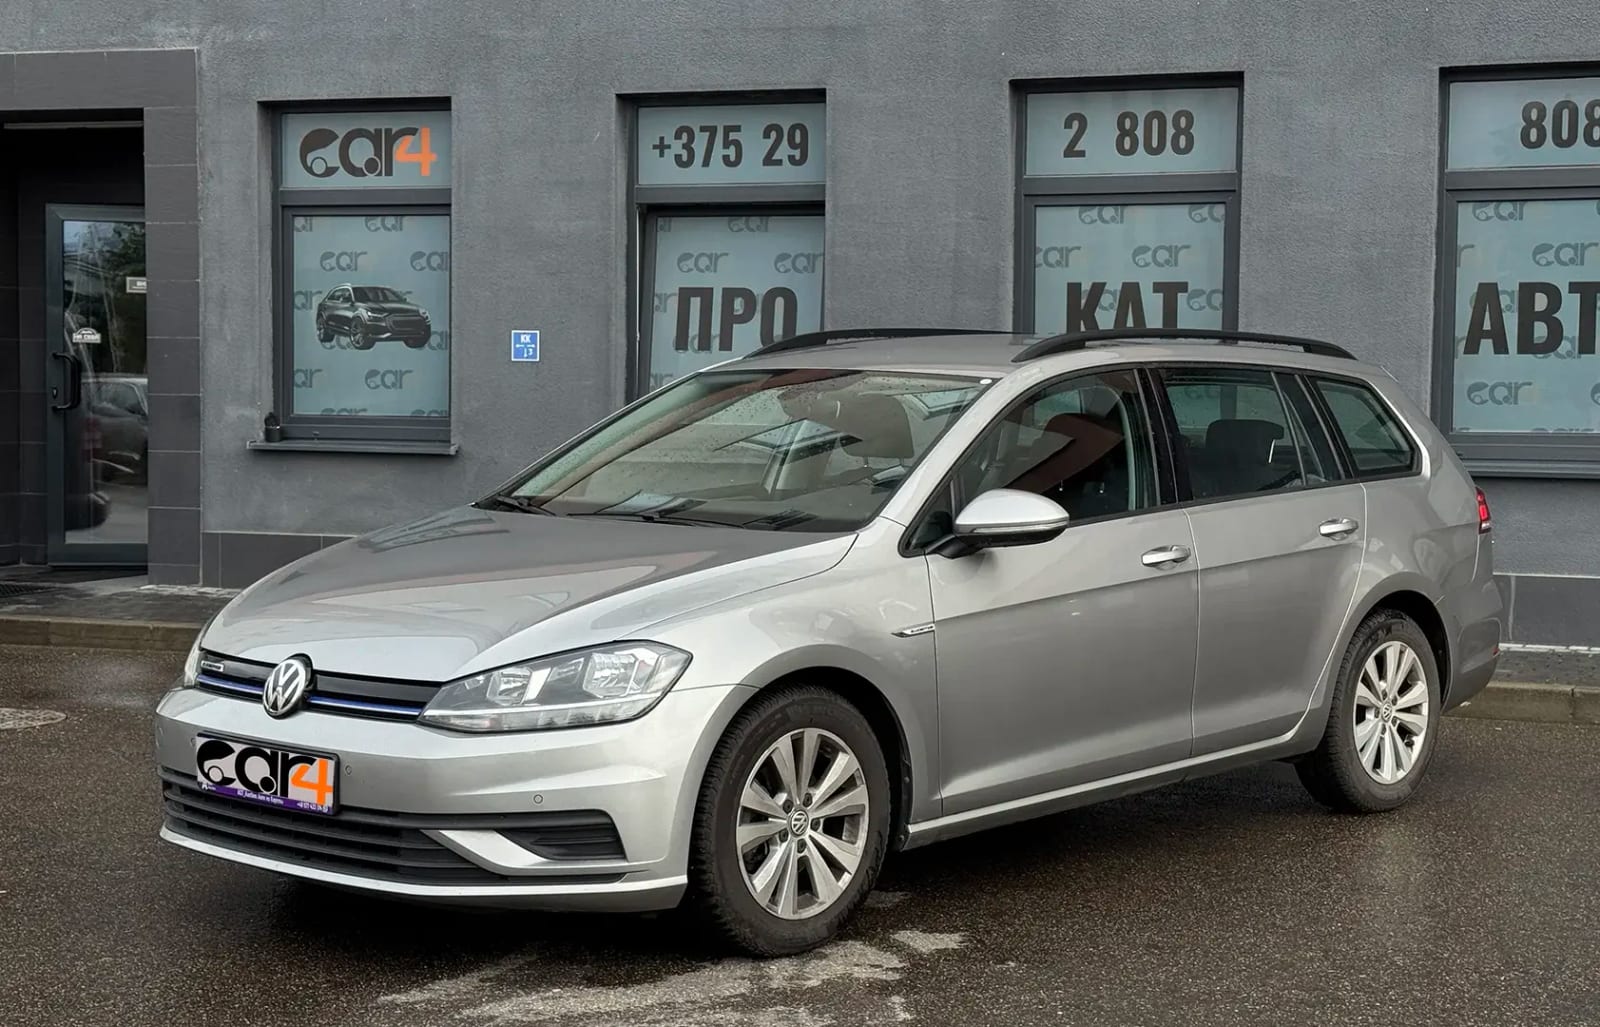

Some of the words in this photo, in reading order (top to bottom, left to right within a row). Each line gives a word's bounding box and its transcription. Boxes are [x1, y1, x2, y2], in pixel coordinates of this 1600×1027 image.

[652, 125, 743, 168] +375
[762, 122, 809, 167] 29
[1063, 112, 1088, 158] 2
[1115, 109, 1195, 156] 808
[675, 286, 798, 352] ПРО
[1066, 281, 1188, 334] КАТ
[1463, 281, 1600, 355] АВТ
